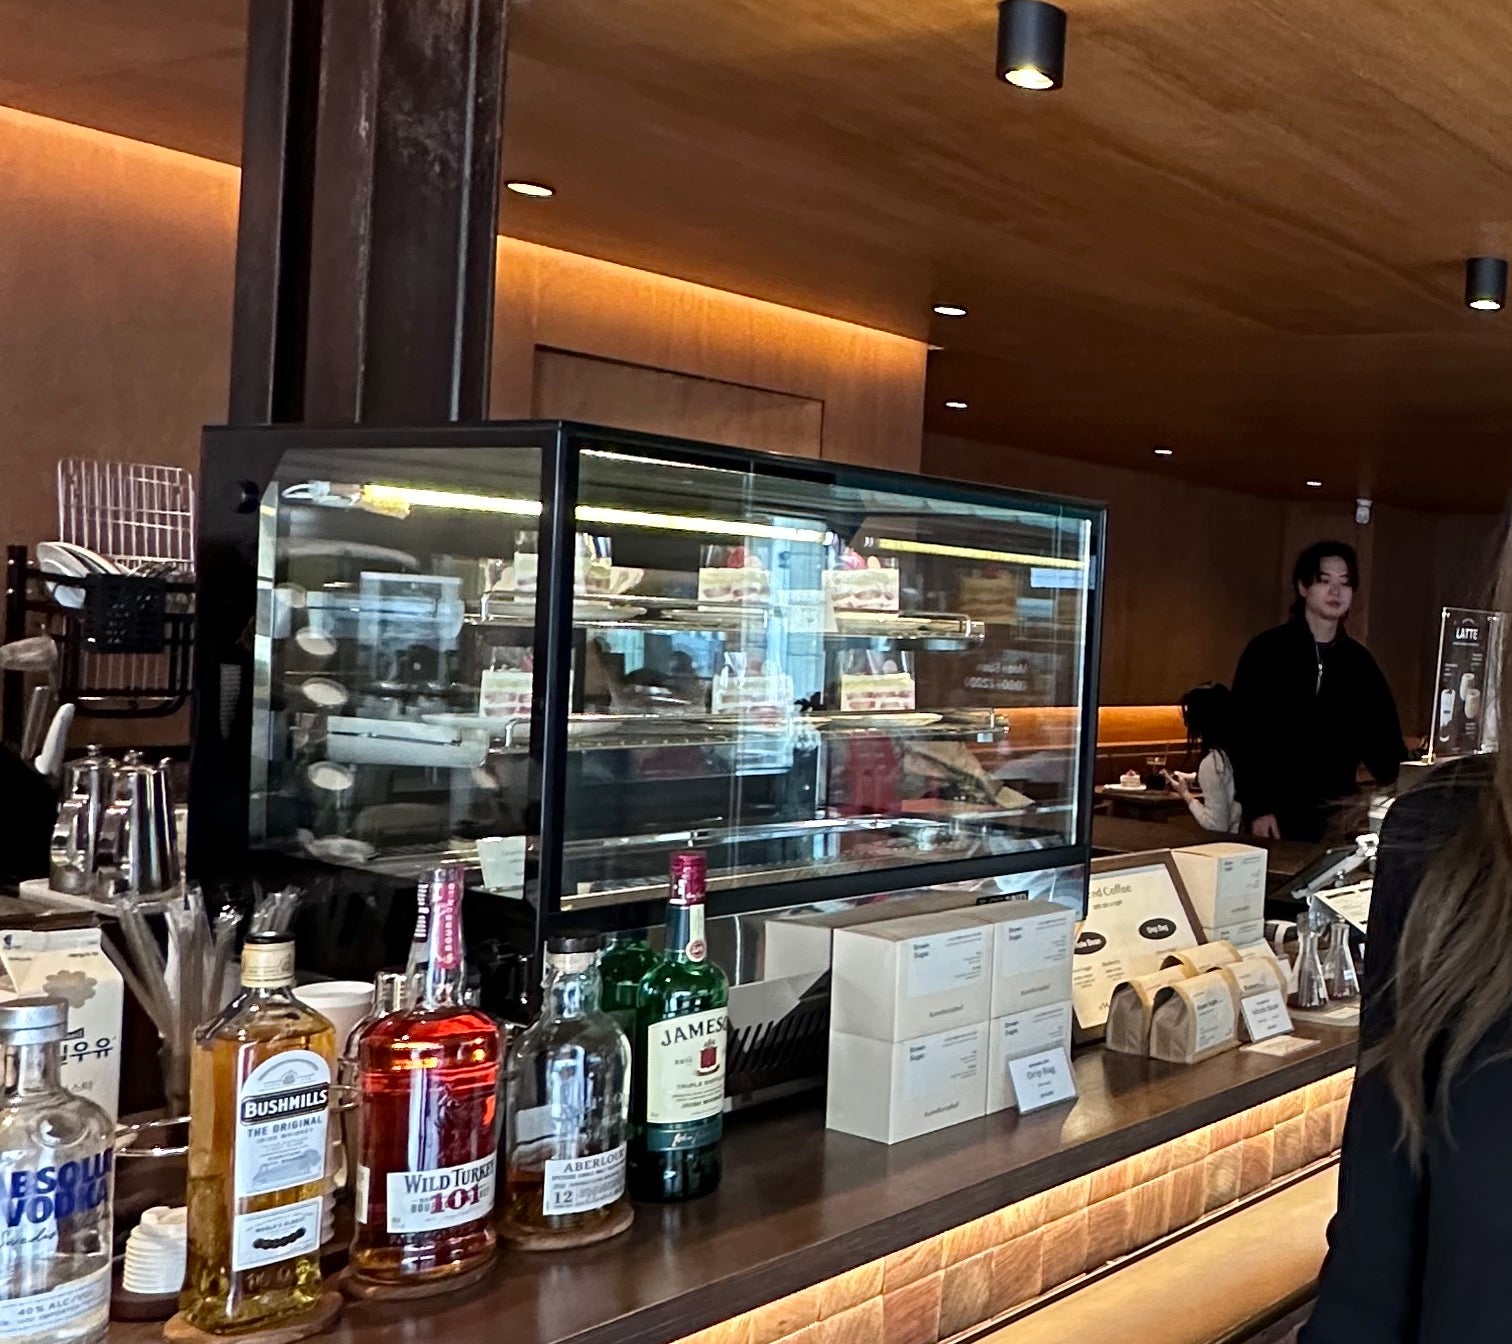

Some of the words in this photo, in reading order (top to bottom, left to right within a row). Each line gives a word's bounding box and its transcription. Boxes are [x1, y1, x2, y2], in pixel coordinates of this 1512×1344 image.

[1456, 627, 1479, 641] LATTE
[245, 1089, 328, 1119] BUSHMILLS
[248, 1126, 269, 1137] THE
[273, 1116, 322, 1134] ORIGINAL
[11, 1147, 113, 1198] BSOLU
[405, 1174, 450, 1194] WILD
[452, 1160, 494, 1188] TURKEY
[7, 1179, 109, 1228] VODKA
[430, 1184, 481, 1214] 101
[555, 1191, 573, 1204] 12
[18, 1306, 45, 1316] 40%
